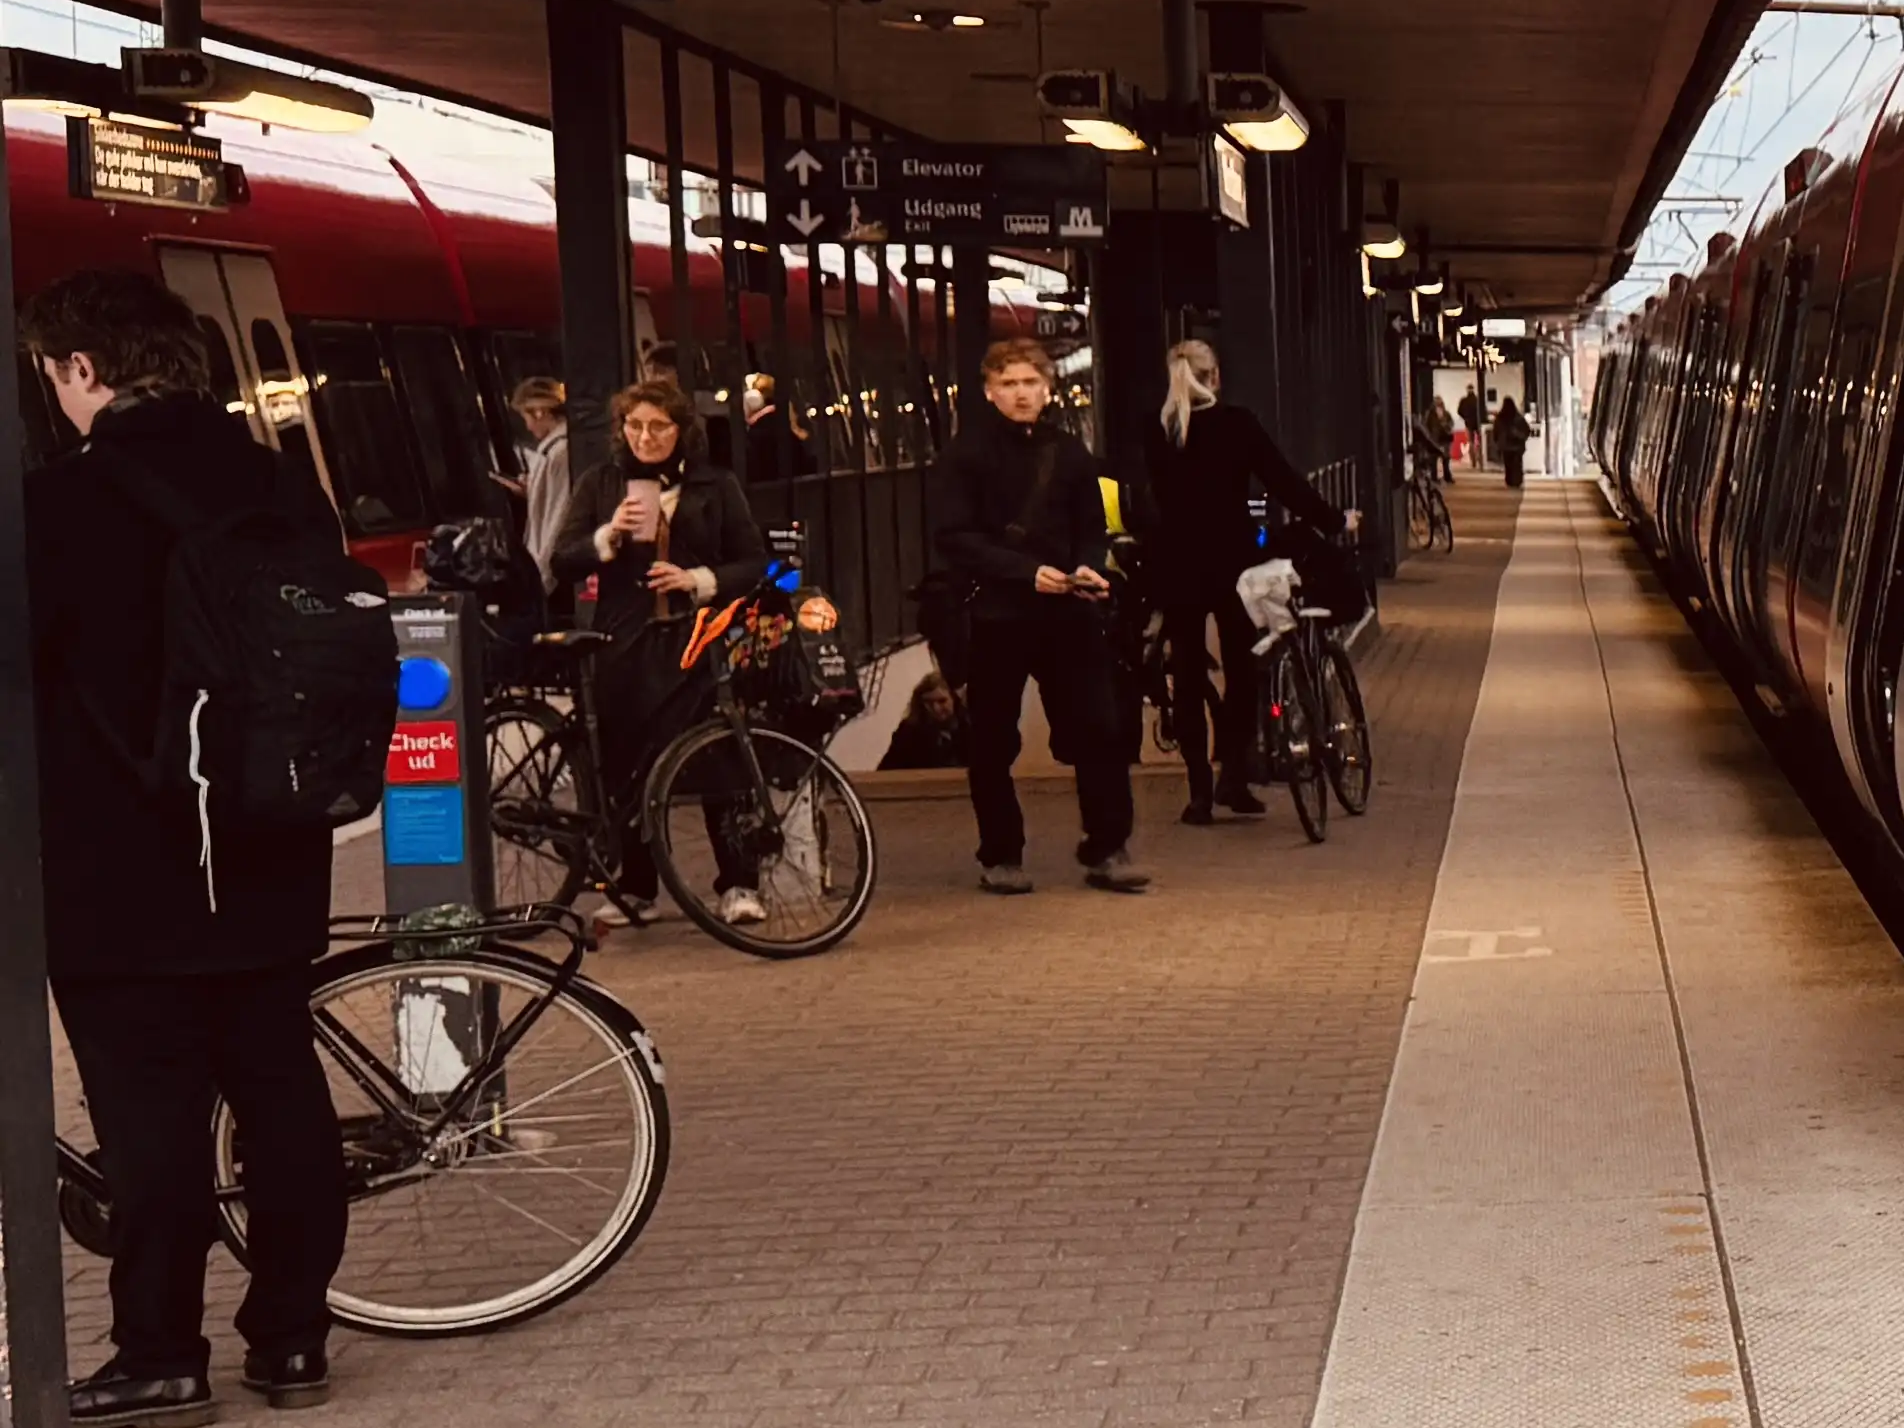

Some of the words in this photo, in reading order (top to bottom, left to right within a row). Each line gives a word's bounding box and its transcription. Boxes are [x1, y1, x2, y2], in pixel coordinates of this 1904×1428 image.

[902, 158, 984, 177] Elevator
[904, 198, 982, 220] Udgang
[905, 219, 931, 233] Exit
[389, 732, 454, 752] Check
[407, 751, 436, 770] ud
